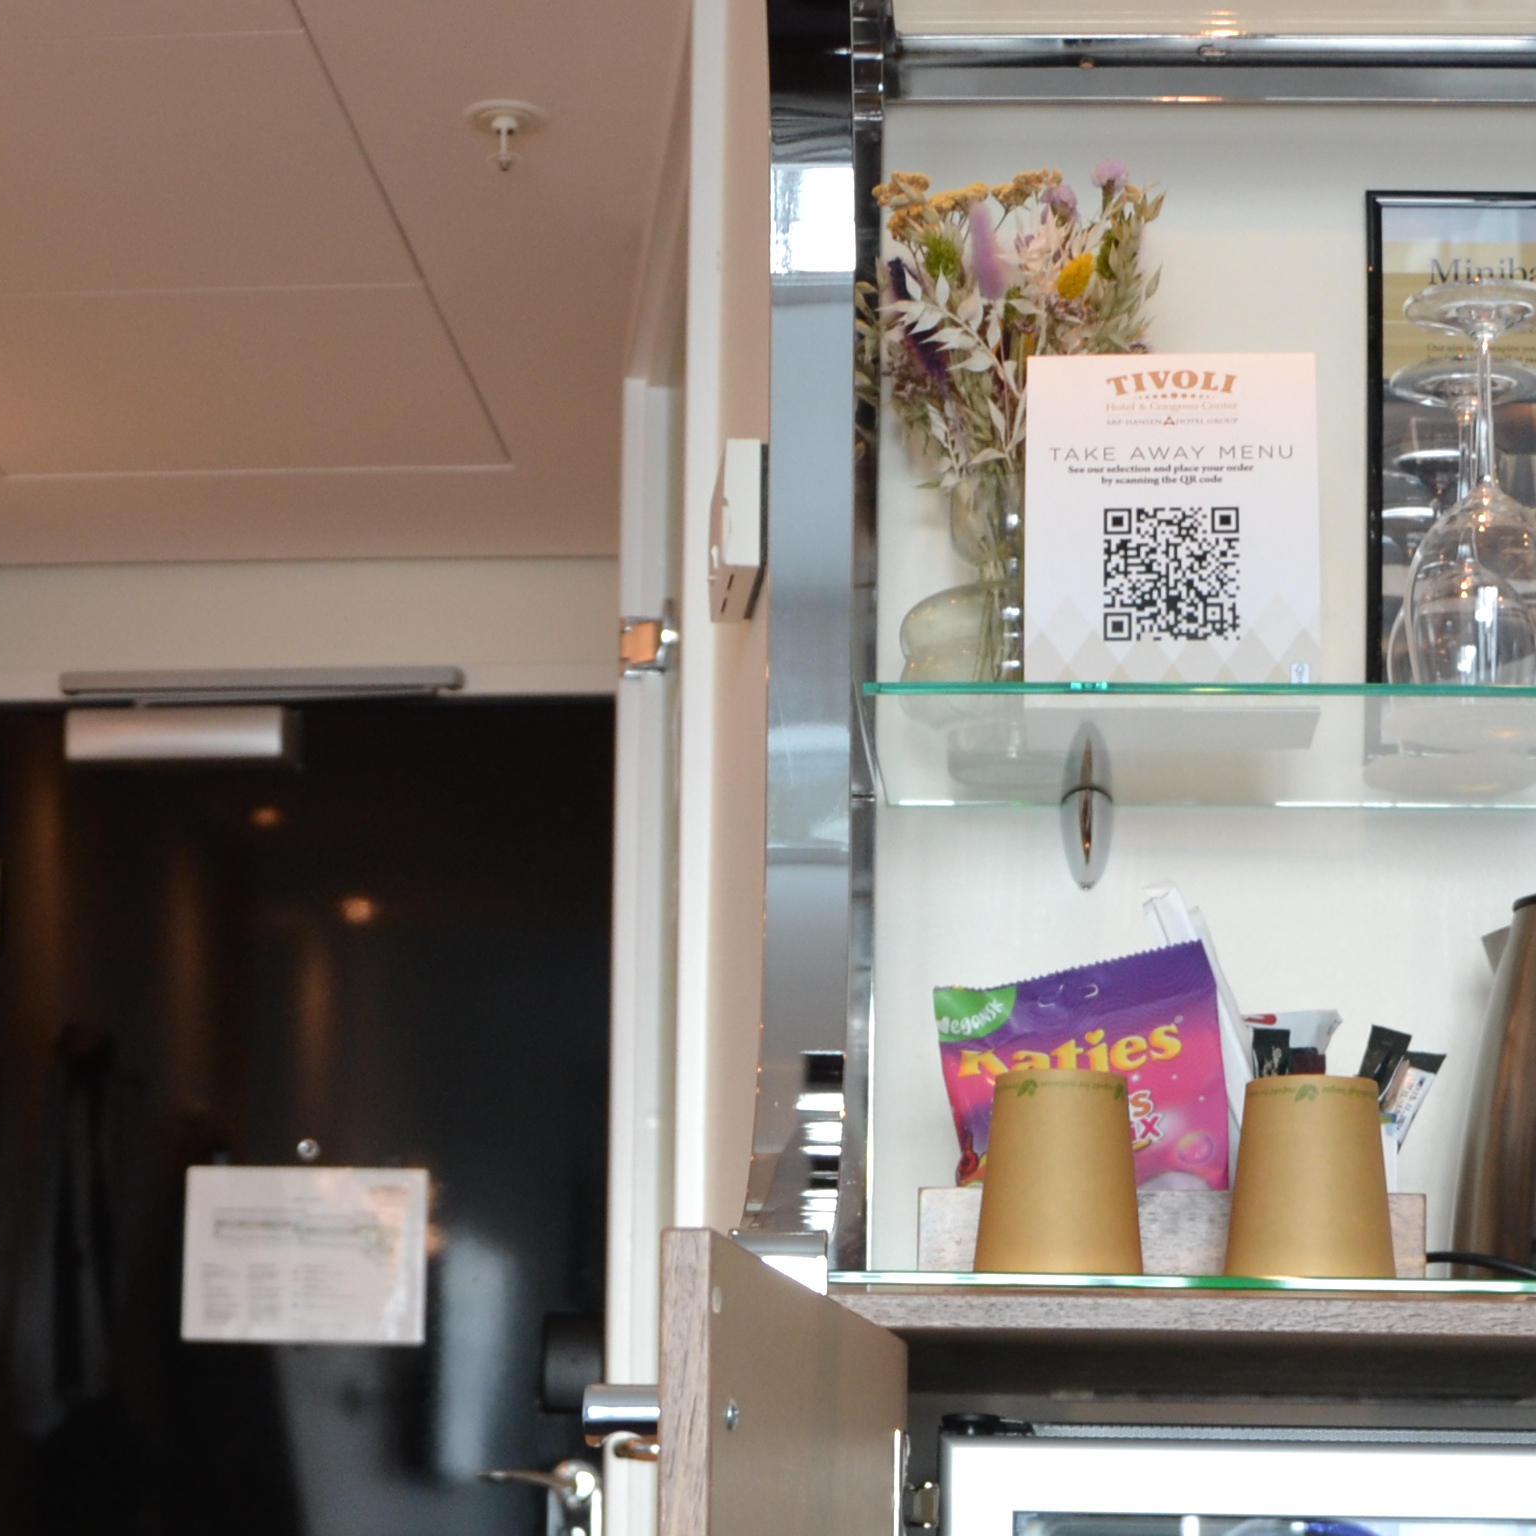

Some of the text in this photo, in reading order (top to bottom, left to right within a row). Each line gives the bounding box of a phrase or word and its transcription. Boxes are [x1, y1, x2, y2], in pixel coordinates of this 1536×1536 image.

[1107, 369, 1237, 397] TIVOLI
[1049, 444, 1293, 461] TAKE AWAY MENU
[1068, 465, 1085, 473] See
[1106, 464, 1151, 473] selection
[1153, 464, 1171, 472] and
[1174, 464, 1199, 474] place
[1202, 465, 1224, 474] your
[1226, 464, 1253, 472] order
[1101, 475, 1222, 485] by scanning the QR code
